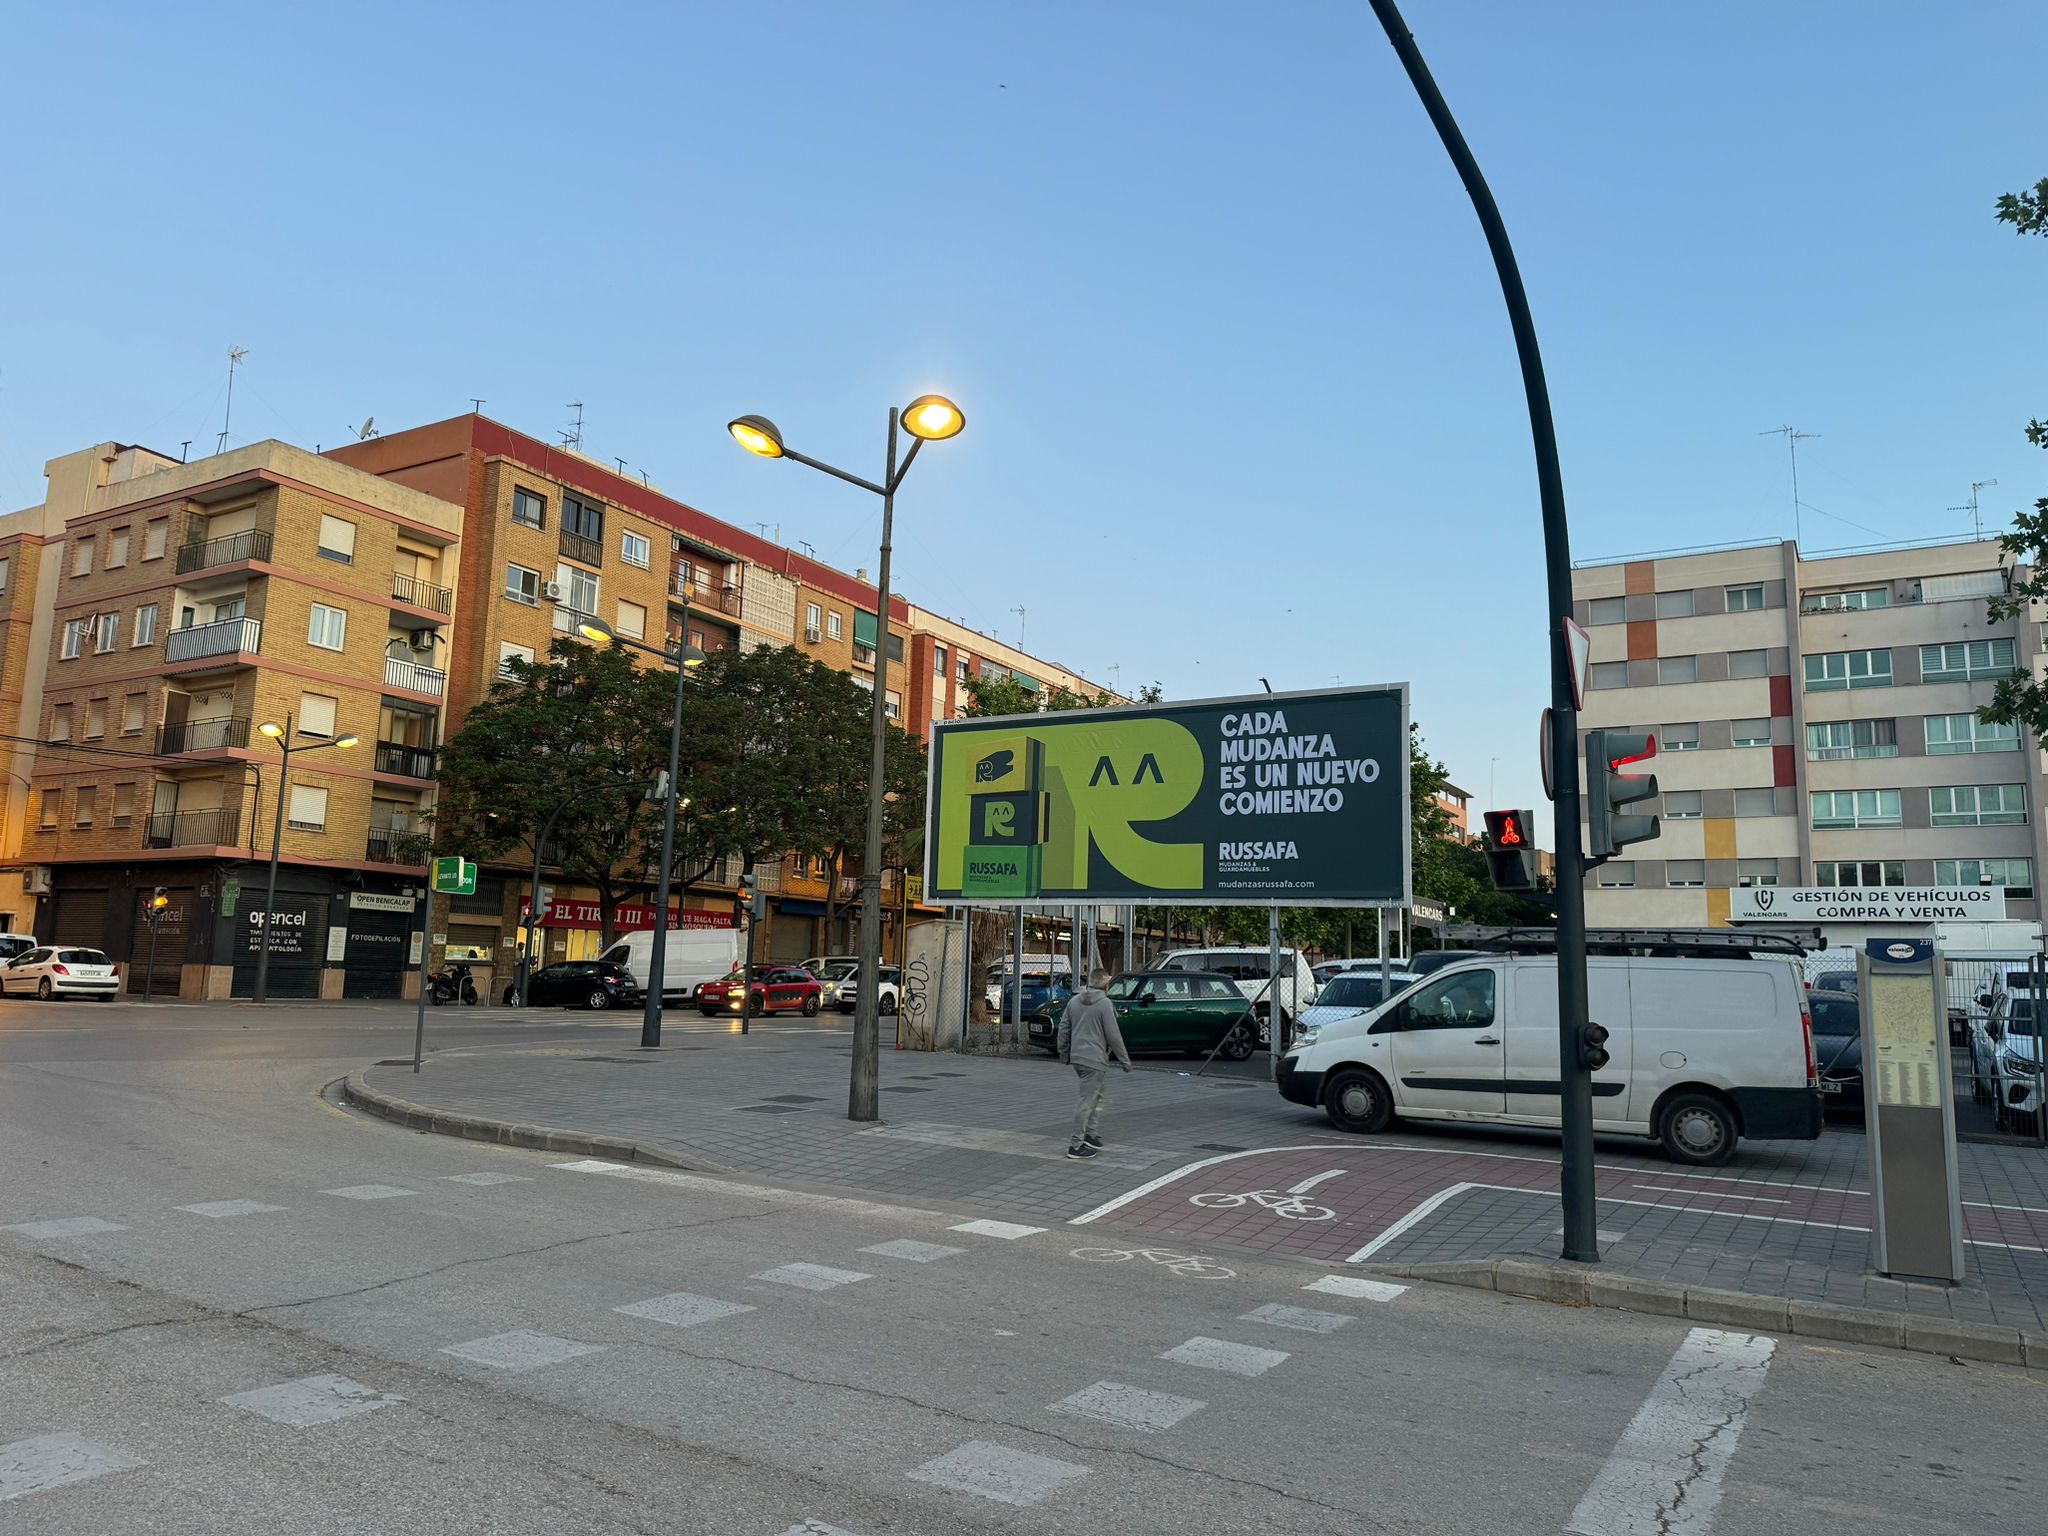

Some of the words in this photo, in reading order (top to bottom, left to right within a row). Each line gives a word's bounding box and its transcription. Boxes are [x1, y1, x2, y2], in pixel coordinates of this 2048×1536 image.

[1220, 710, 1288, 737] CADA
[1220, 734, 1337, 763] MUDANZA
[1220, 765, 1246, 789] ES
[1255, 763, 1288, 788] UN
[1297, 758, 1380, 786] NUEVO
[1219, 787, 1344, 816] COMIENZO
[1219, 841, 1299, 860] RUSSAFA
[969, 862, 1018, 876] RUSSAFA
[1218, 880, 1315, 888] mudanzasrussafa.com
[375, 897, 411, 907] BENICALAP
[1792, 889, 1862, 902] GESTIÓN
[1869, 891, 1889, 902] DE
[1894, 888, 1991, 902] VEHÍCULOS
[555, 904, 572, 919] EL
[625, 909, 643, 924] III
[1411, 904, 1443, 922] VALENCARS
[1816, 906, 1890, 918] COMPRA
[1894, 907, 1905, 917] Y
[1910, 906, 1967, 917] VENTA
[693, 915, 712, 924] HAGA
[712, 918, 732, 926] FALTA
[351, 933, 401, 943] FOTODEPILACIÓN
